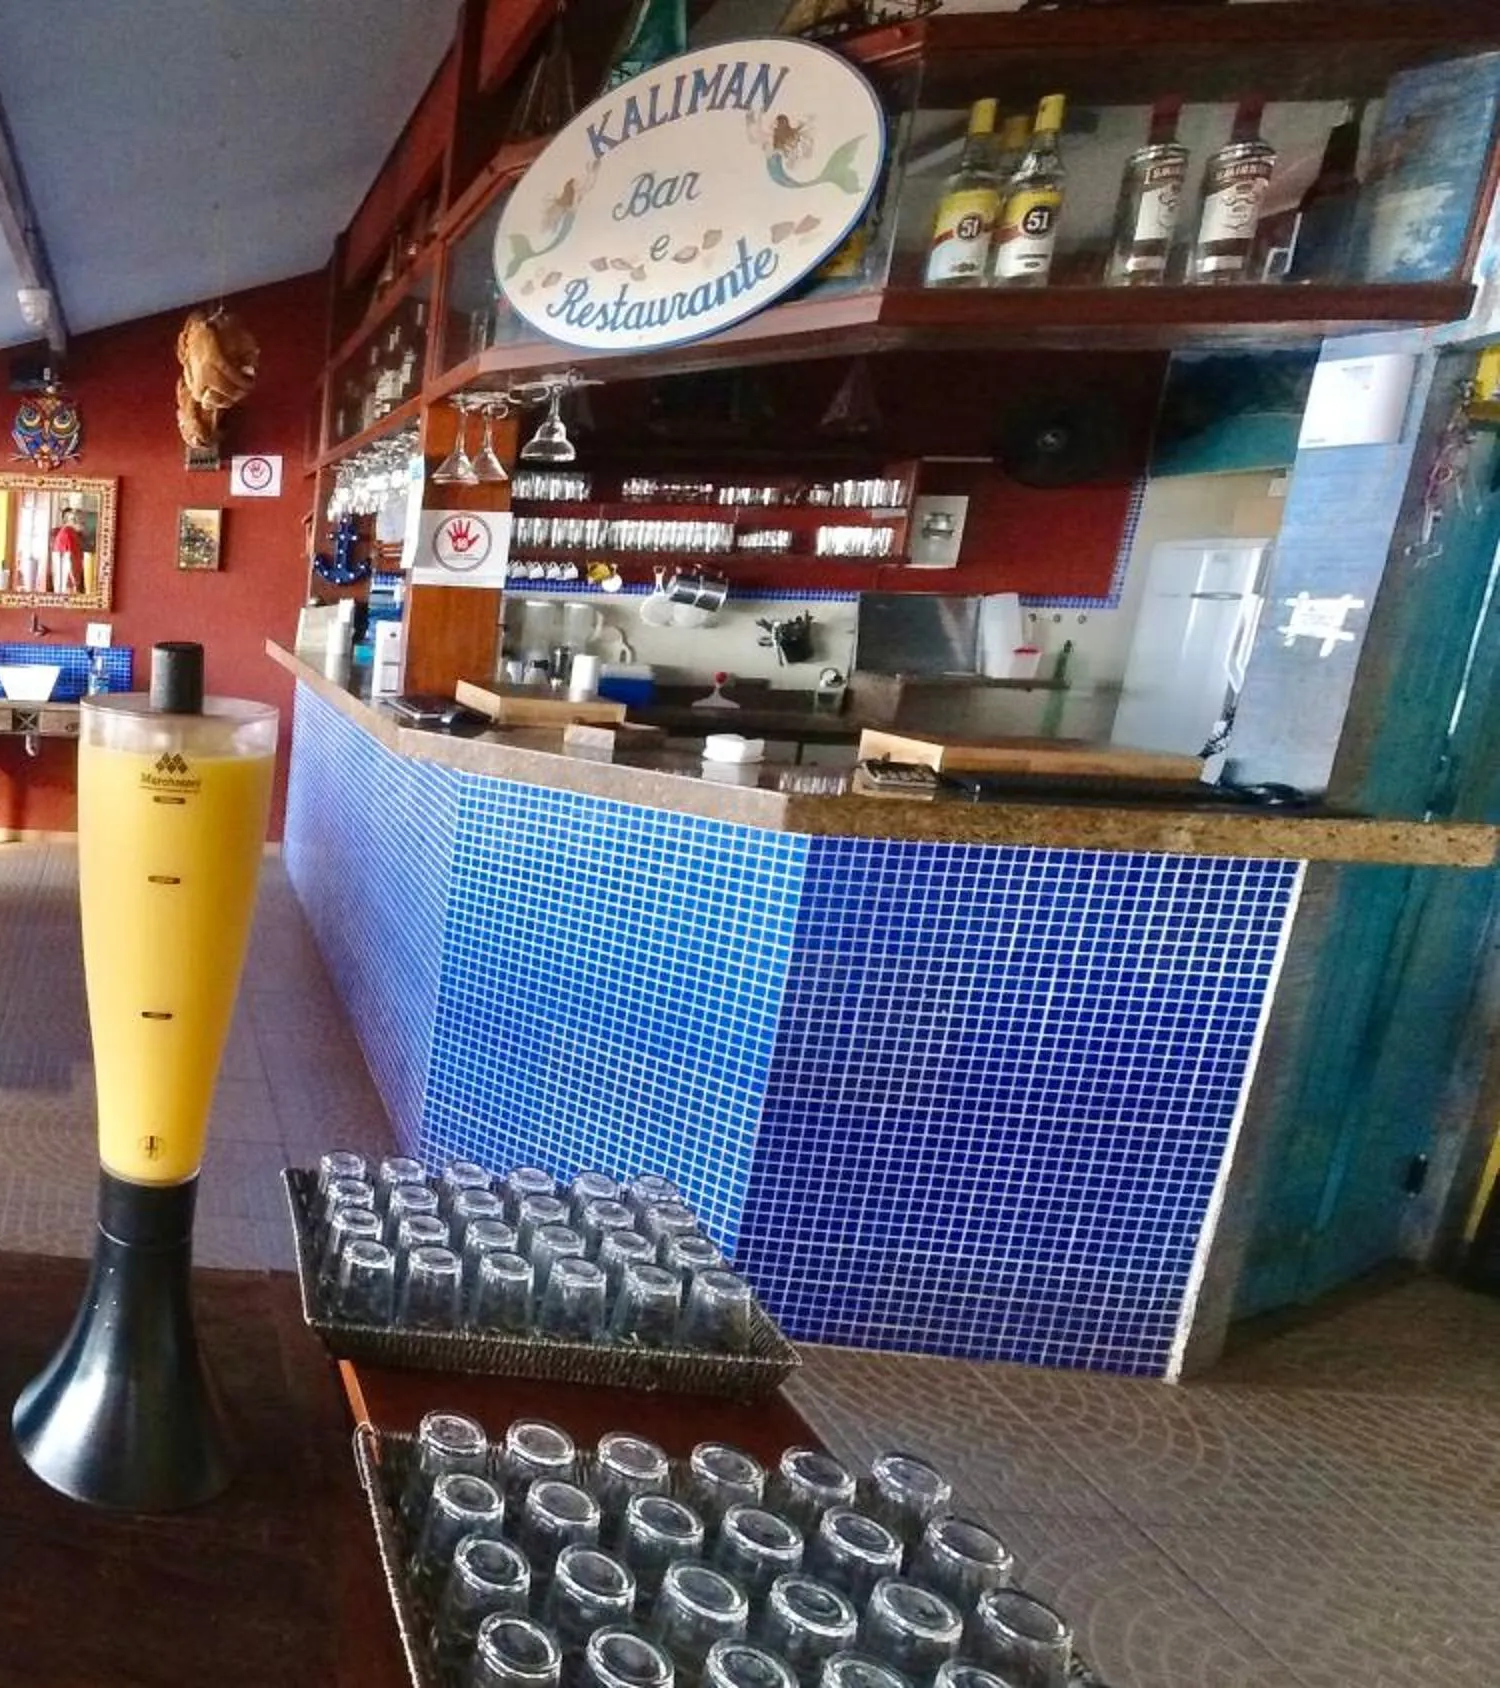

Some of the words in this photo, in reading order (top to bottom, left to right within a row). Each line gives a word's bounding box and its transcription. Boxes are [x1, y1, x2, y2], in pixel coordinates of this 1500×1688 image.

[586, 61, 790, 159] KALIMAN
[612, 170, 700, 221] Bar
[960, 218, 979, 237] 51
[1026, 210, 1049, 231] 51
[649, 234, 671, 261] e
[546, 236, 780, 333] Restaurante
